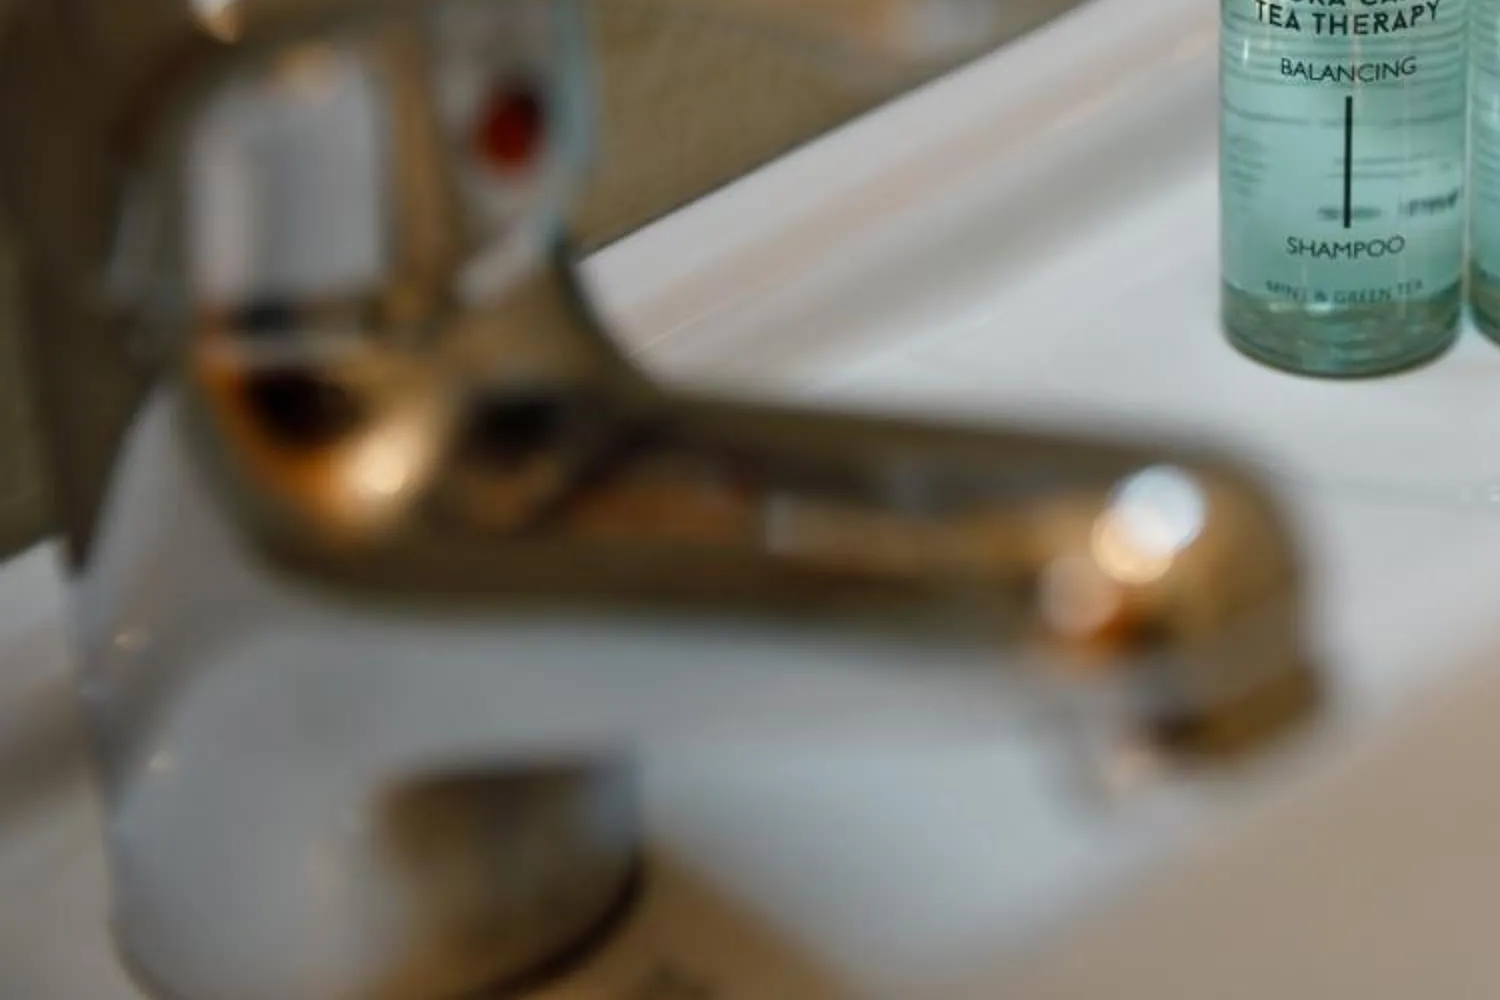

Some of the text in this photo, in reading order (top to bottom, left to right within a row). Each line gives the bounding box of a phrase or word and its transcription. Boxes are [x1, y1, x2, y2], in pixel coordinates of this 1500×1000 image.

[1255, 0, 1301, 31] TEA
[1280, 56, 1417, 83] BALANCING
[1286, 235, 1405, 259] SHAMPOO
